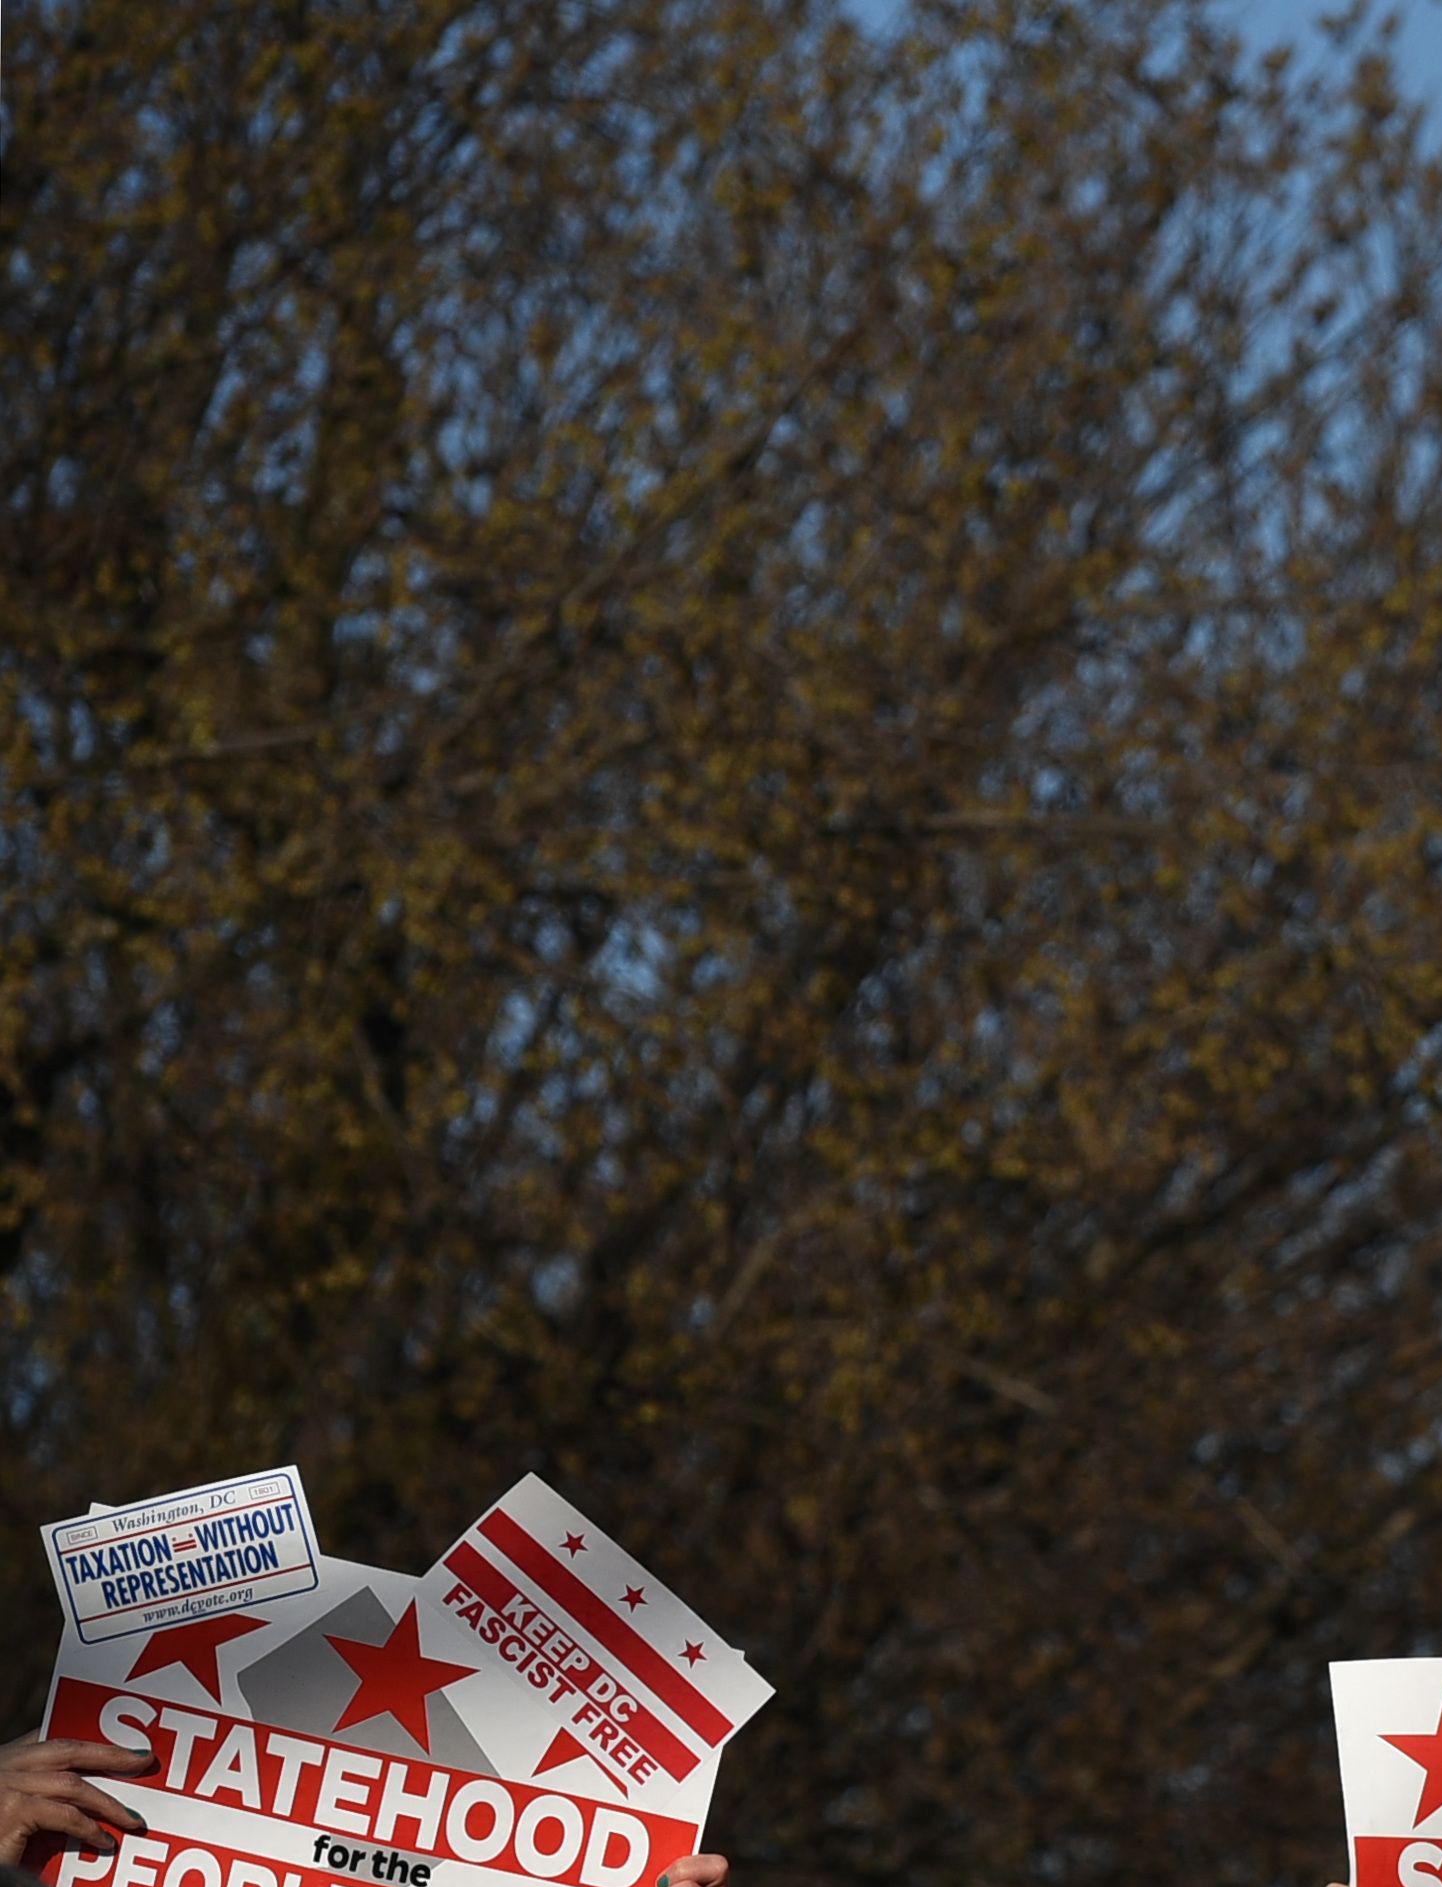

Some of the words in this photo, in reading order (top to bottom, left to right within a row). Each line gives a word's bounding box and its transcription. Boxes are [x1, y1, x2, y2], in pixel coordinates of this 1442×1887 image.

[66, 1534, 173, 1585] TAXATION
[194, 1503, 295, 1552] WITHOUT
[112, 1504, 204, 1533] Washington,
[209, 1490, 237, 1510] DC
[102, 1541, 280, 1610] REPRESENTATION
[142, 1587, 254, 1623] www.dcvote.org
[441, 1582, 577, 1705] FASCIST
[571, 1702, 659, 1786] FREE
[502, 1592, 591, 1673] KEEP
[587, 1672, 639, 1723] DC
[312, 1834, 368, 1874] for
[371, 1846, 432, 1887] the
